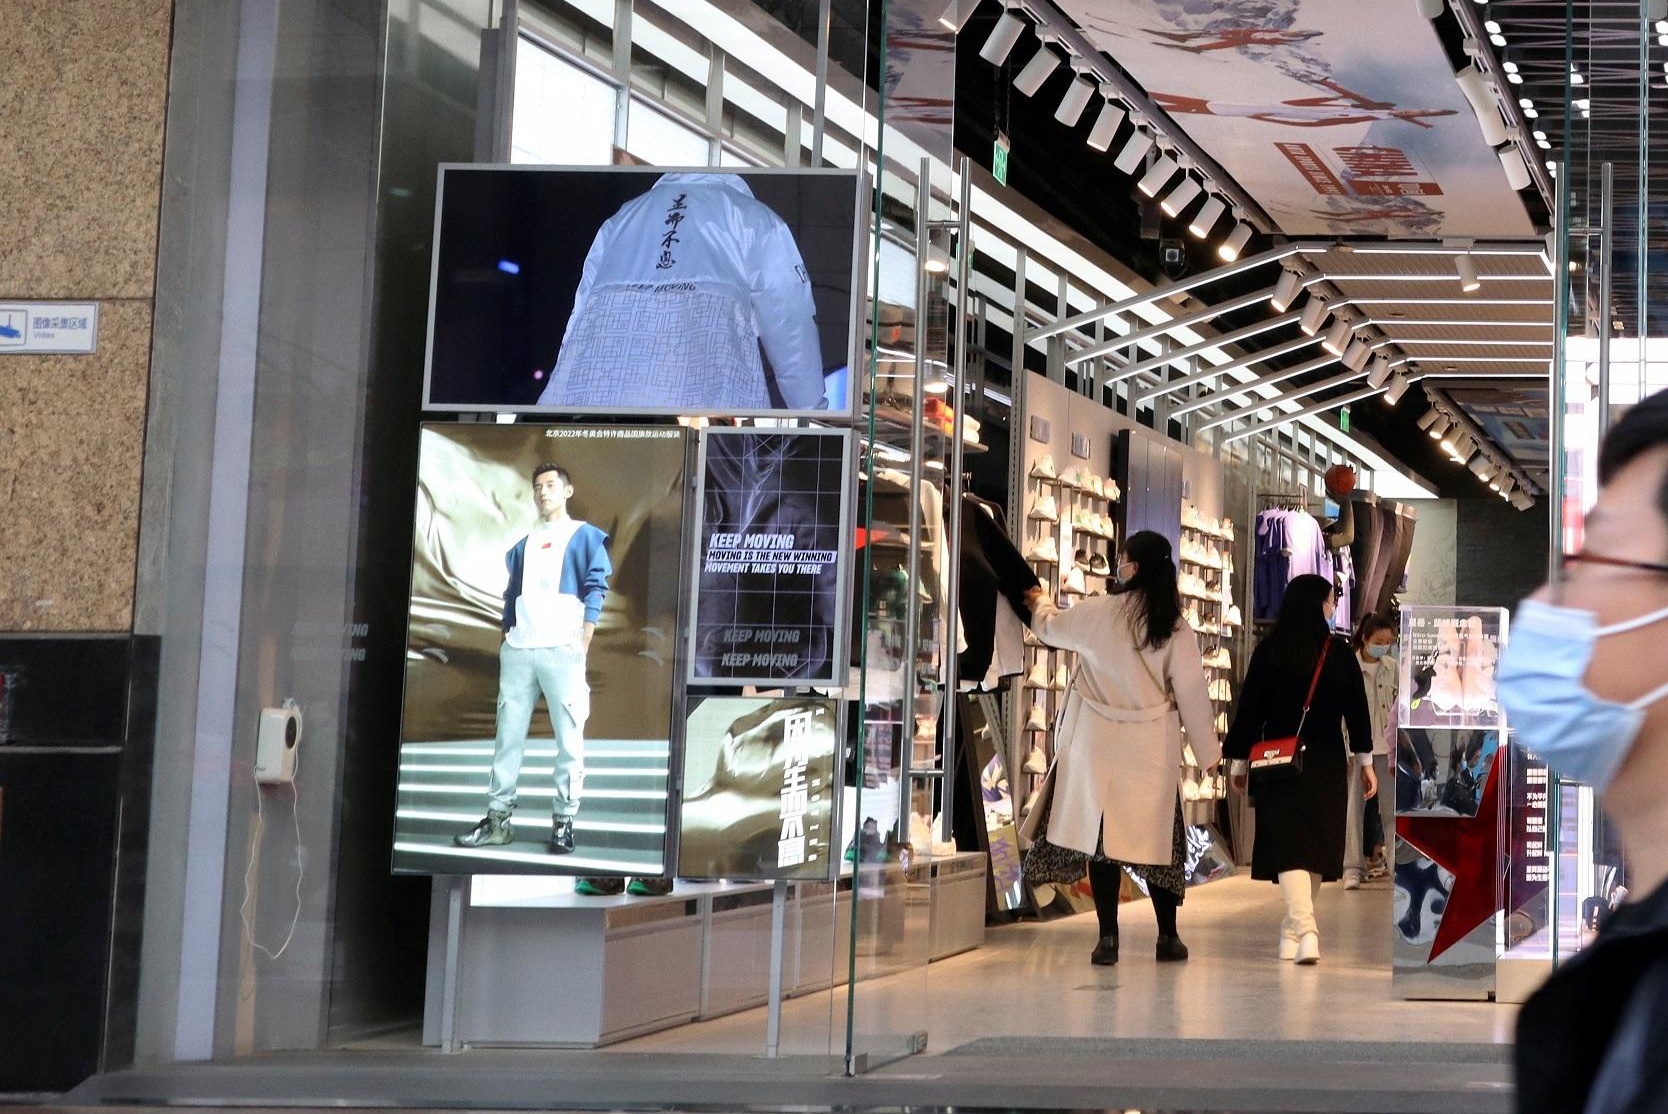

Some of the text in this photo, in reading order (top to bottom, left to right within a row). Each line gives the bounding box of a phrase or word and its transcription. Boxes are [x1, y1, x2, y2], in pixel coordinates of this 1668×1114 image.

[709, 533, 795, 550] KEEP MOVING
[708, 550, 833, 562] MOVING IS THE NEW WINNING
[704, 562, 823, 575] MOVEMENT TAKES YOU THERE
[724, 629, 800, 643] KEEP MOVING
[721, 653, 798, 667] KEEP MOVING
